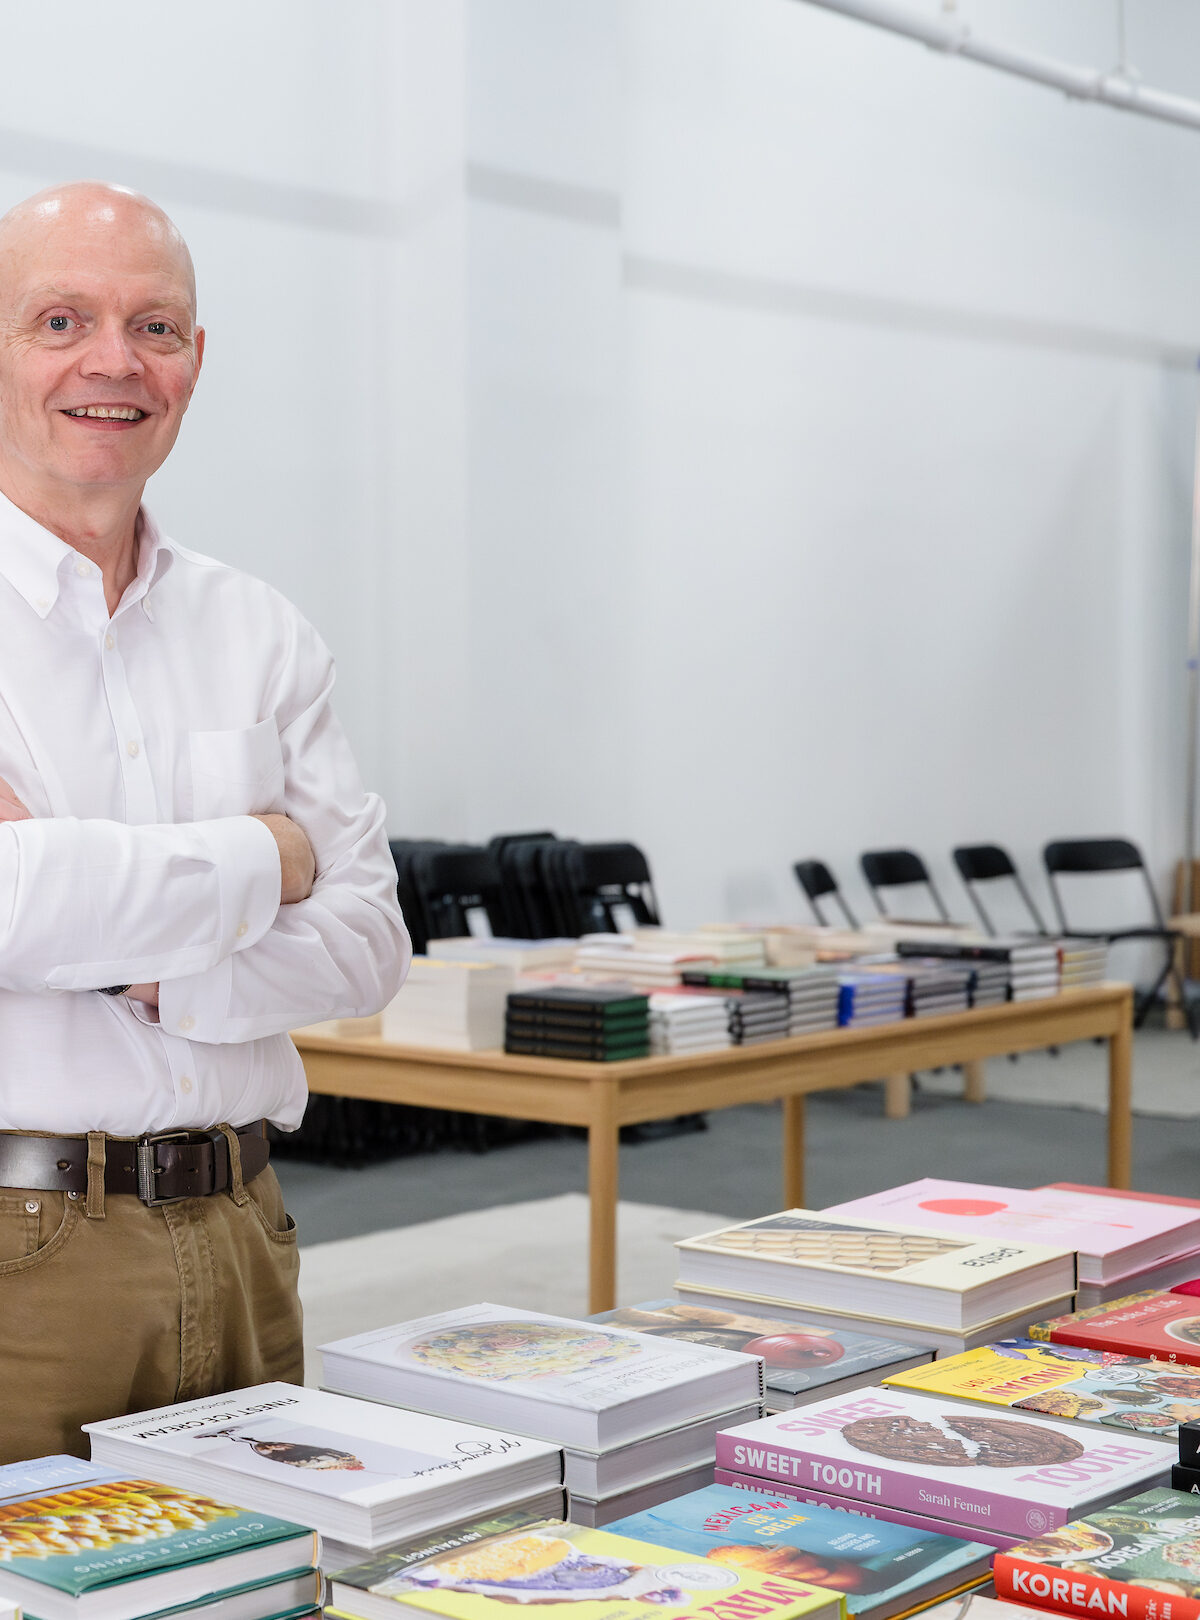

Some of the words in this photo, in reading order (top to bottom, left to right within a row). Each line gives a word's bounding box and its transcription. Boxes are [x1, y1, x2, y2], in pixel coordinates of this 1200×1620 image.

[959, 1246, 1026, 1268] pasta
[1086, 1319, 1119, 1328] The
[1152, 1299, 1183, 1309] Life
[980, 1367, 1076, 1398] INDIAN
[202, 1408, 240, 1424] ICE
[243, 1397, 301, 1416] FINEST
[776, 1397, 907, 1438] SWEET
[133, 1420, 205, 1440] CREAM
[47, 1462, 98, 1481] The
[1013, 1443, 1154, 1488] TOOTH
[733, 1445, 802, 1477] SWEET
[810, 1461, 883, 1496] TOOTH
[918, 1488, 951, 1508] Sarah
[953, 1495, 992, 1517] Fennel
[703, 1500, 791, 1533] MEXICAN
[742, 1512, 777, 1527] ICE
[753, 1514, 813, 1537] CREAM
[174, 1522, 265, 1551] CLAUDIA
[458, 1531, 483, 1543] ABI
[73, 1546, 172, 1574] FLEMING
[400, 1539, 462, 1564] BALINGIT
[1088, 1534, 1166, 1570] KOREAN
[1011, 1567, 1129, 1618] KOREAN
